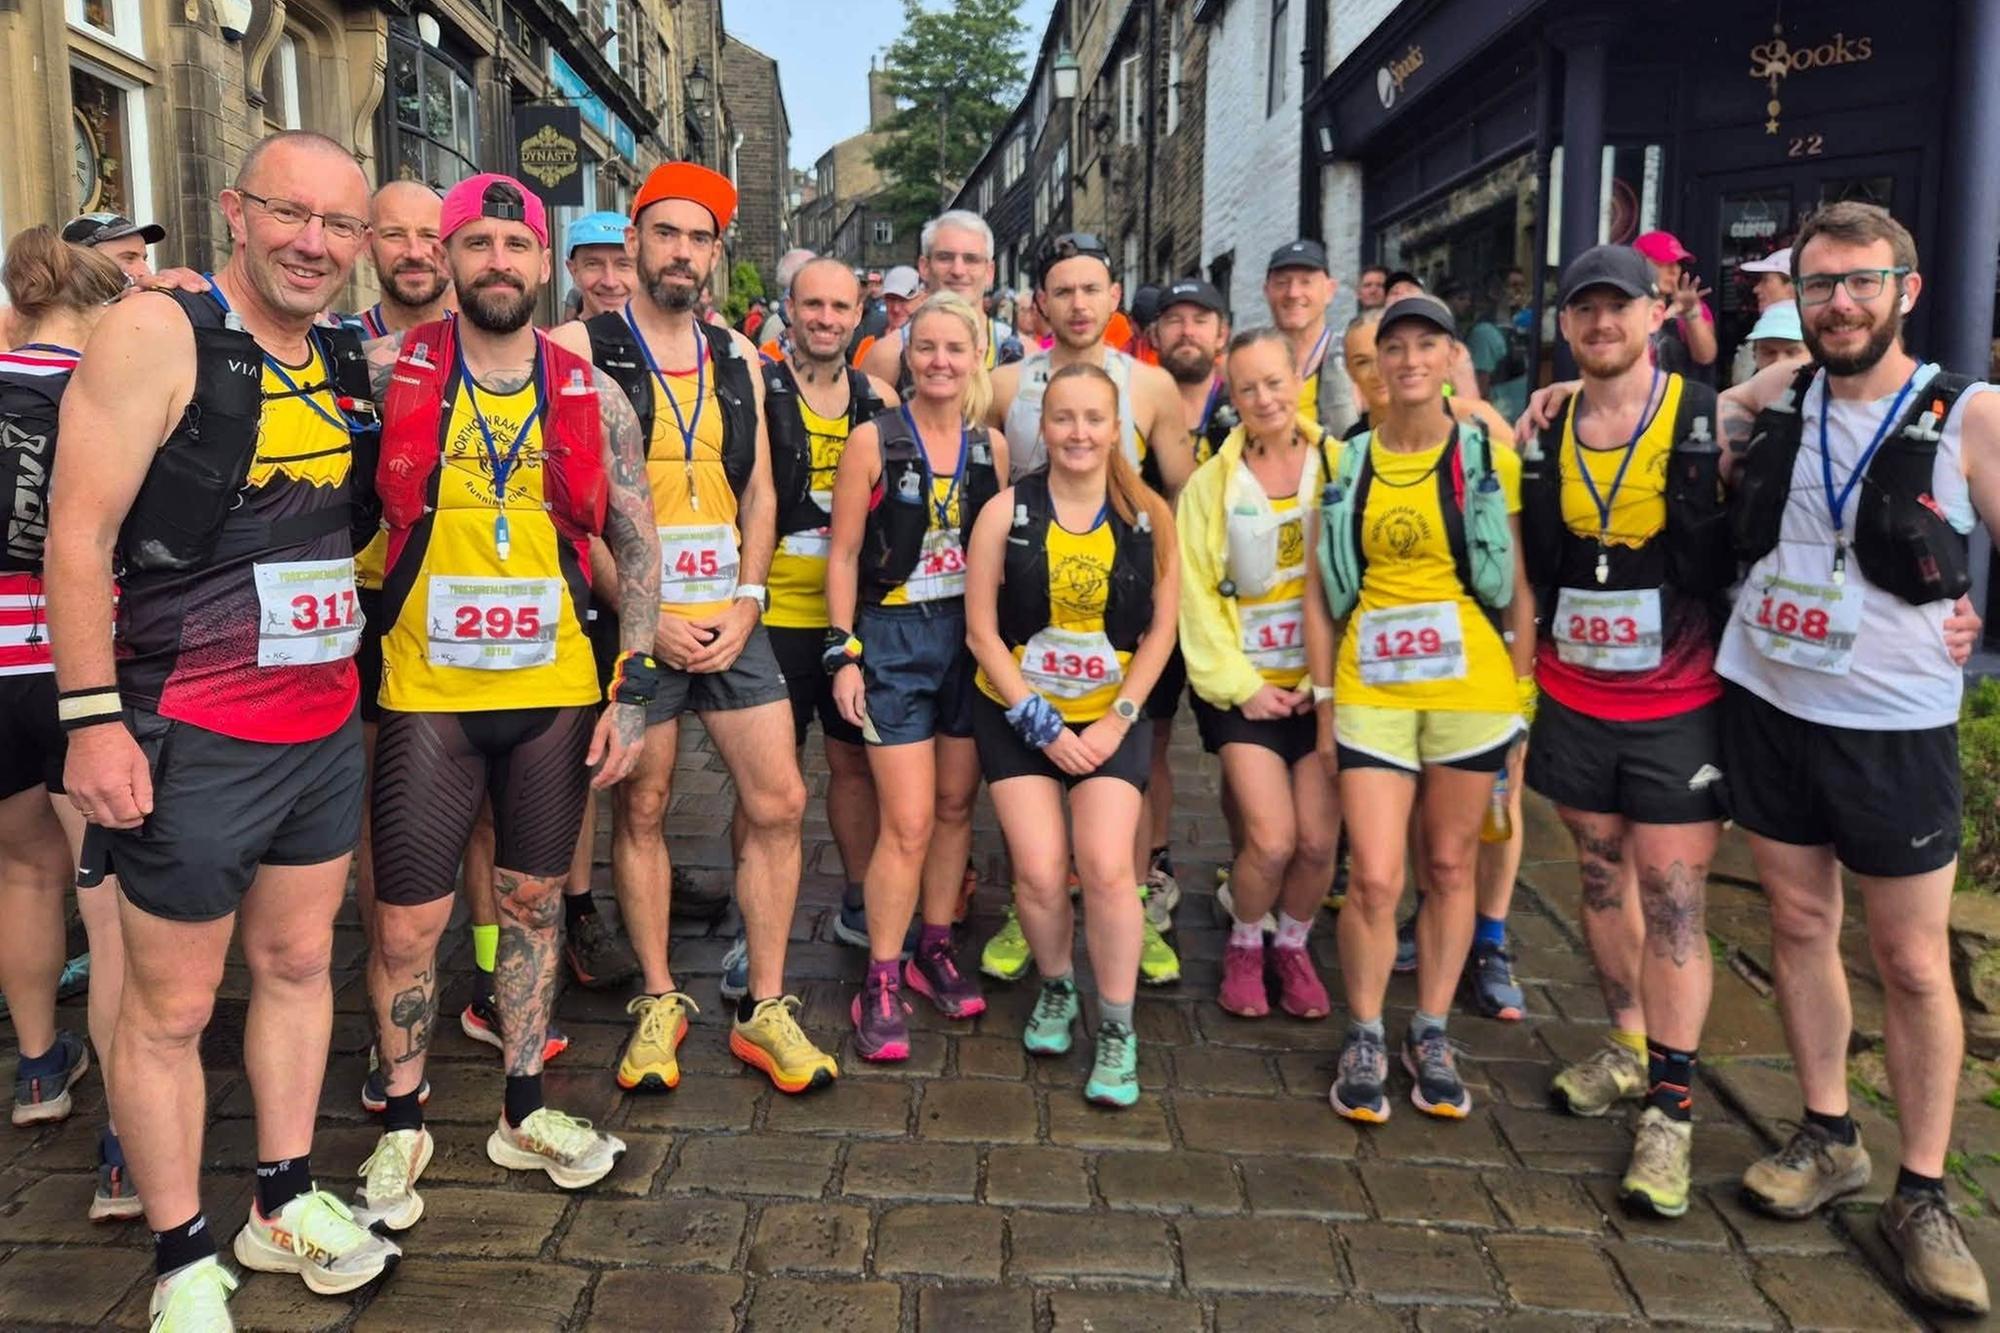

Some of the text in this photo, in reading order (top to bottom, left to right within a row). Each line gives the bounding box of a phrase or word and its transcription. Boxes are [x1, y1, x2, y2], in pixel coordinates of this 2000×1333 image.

[521, 150, 577, 163] DYNASTY
[1788, 135, 1824, 158] 22
[464, 480, 528, 508] Runnin Club
[675, 550, 719, 577] 45
[291, 590, 354, 631] 317
[455, 605, 542, 639] 295
[1756, 597, 1830, 639] 168
[1375, 628, 1442, 657] 129
[1569, 614, 1638, 643] 283
[1042, 651, 1106, 680] 136
